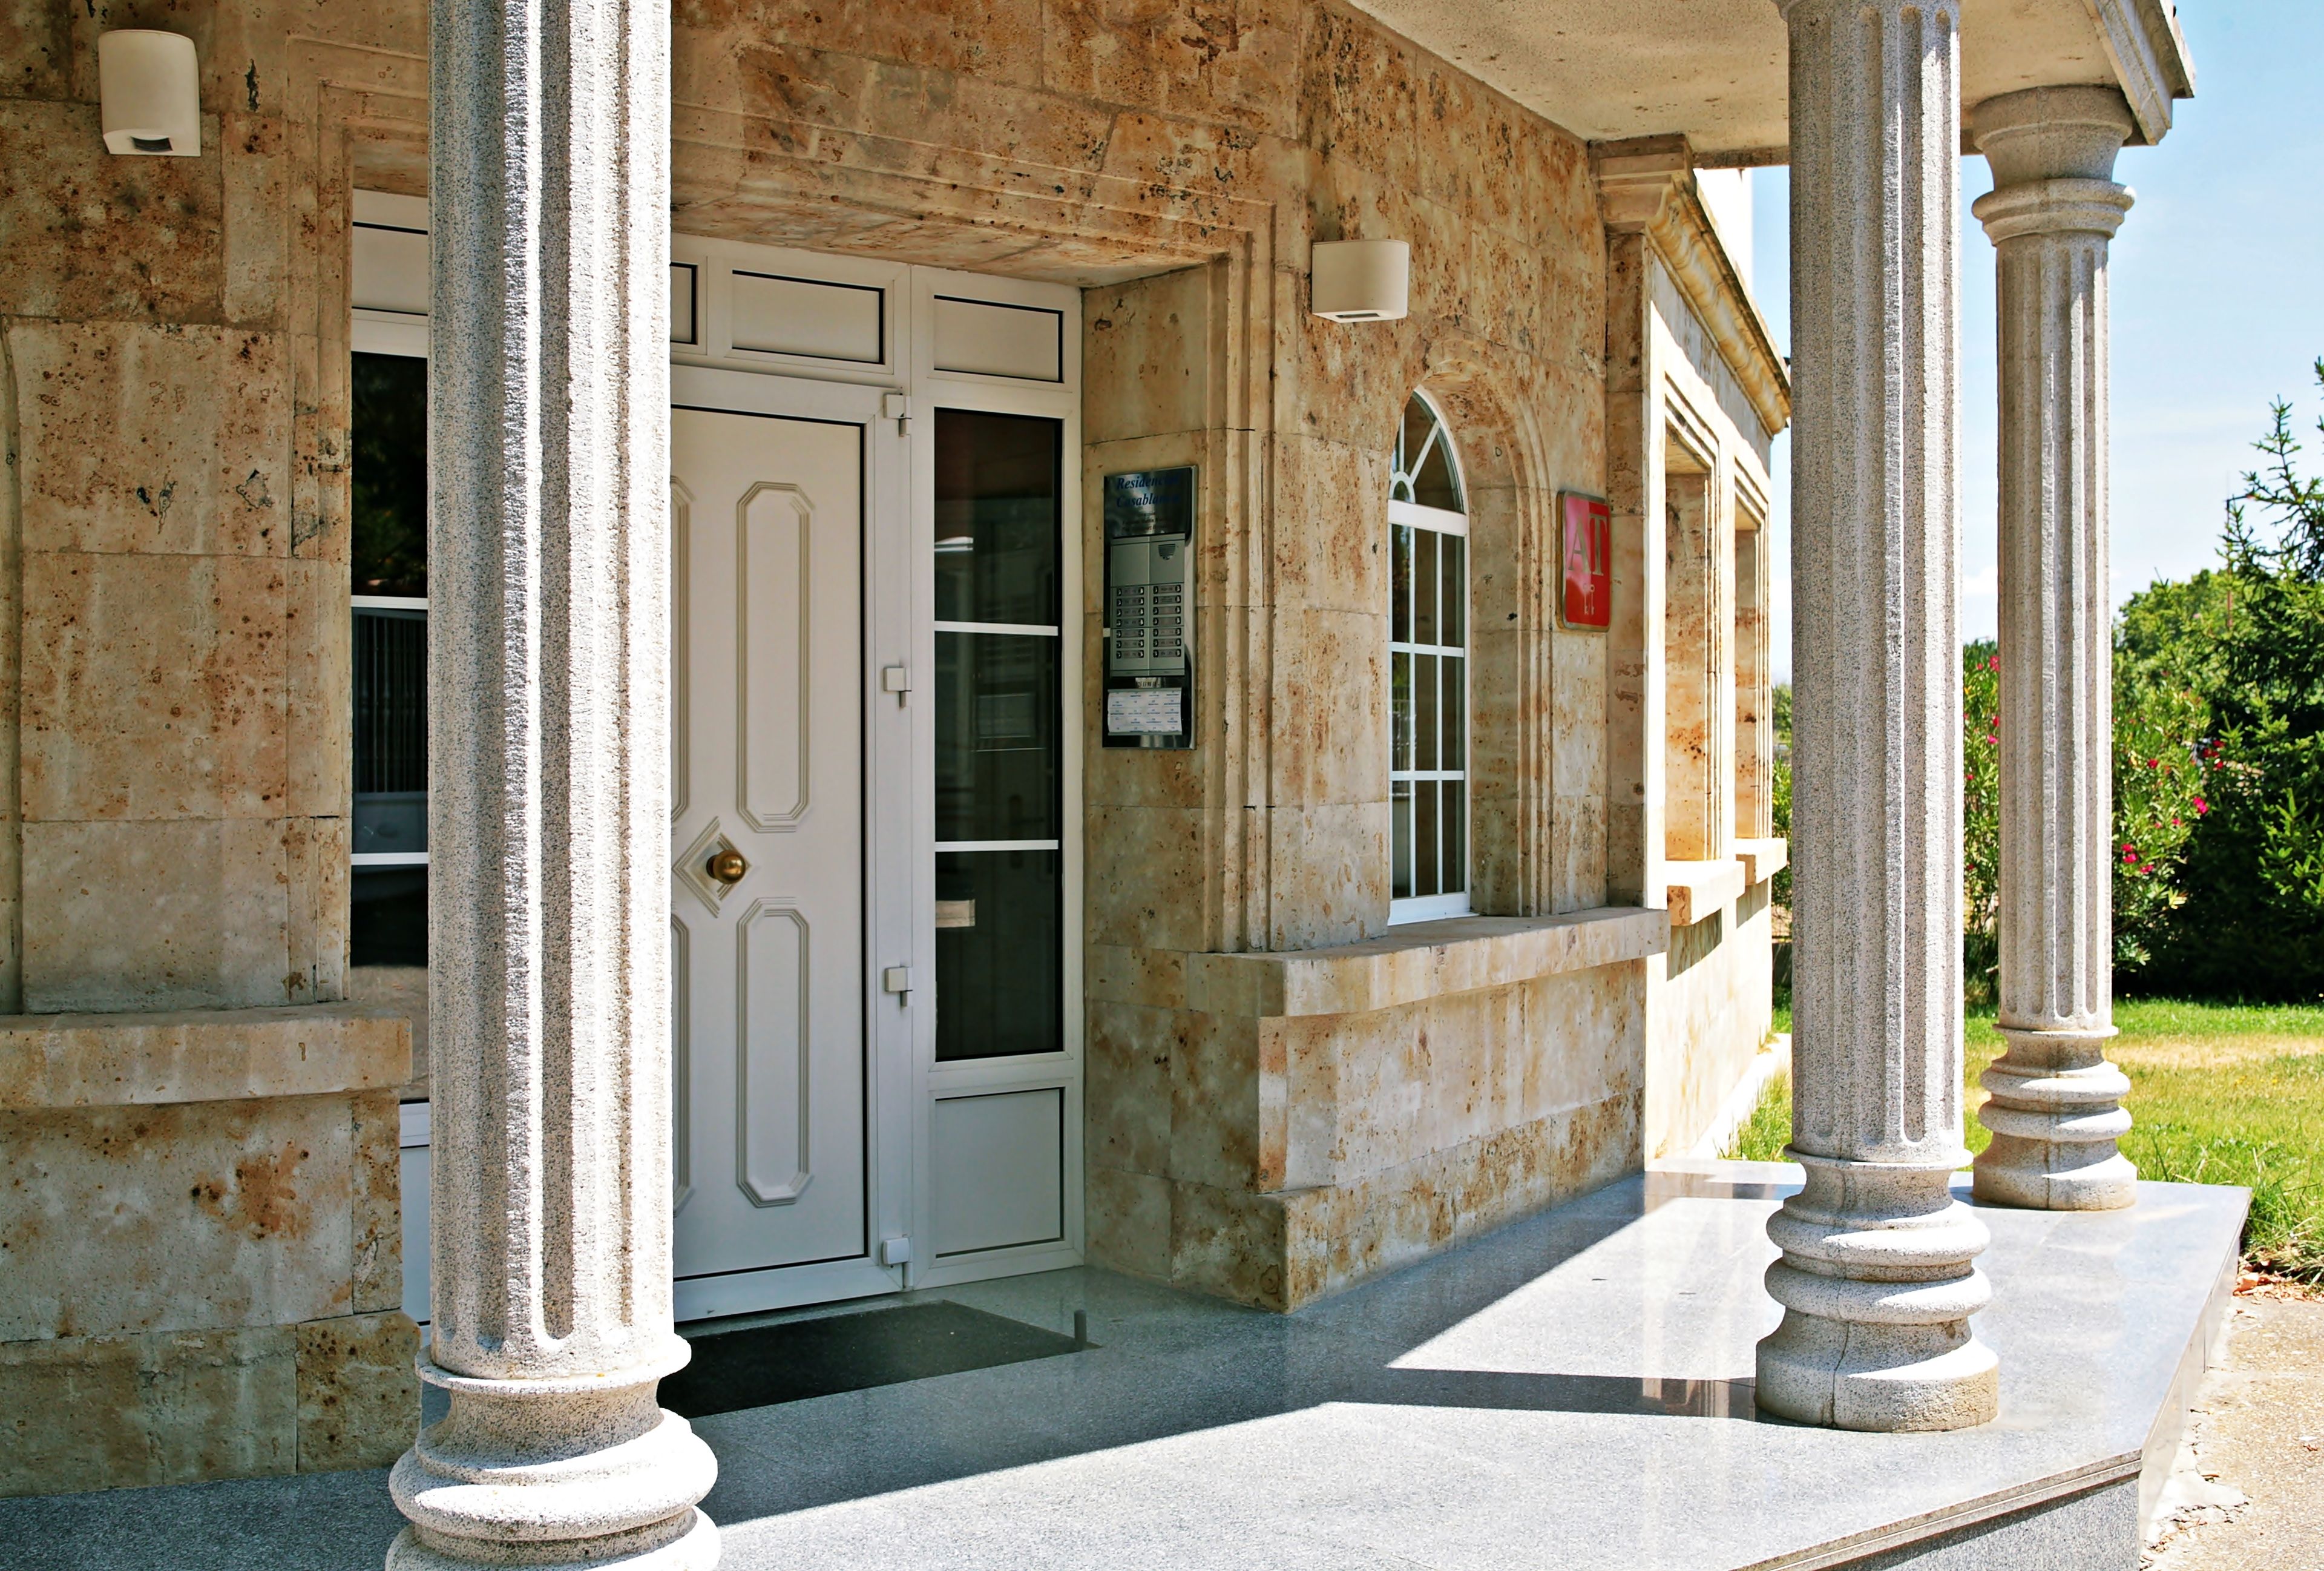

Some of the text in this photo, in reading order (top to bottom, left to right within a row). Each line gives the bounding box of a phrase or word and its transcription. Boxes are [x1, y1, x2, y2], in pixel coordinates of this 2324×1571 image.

[1117, 474, 1181, 489] Residenc
[1117, 493, 1181, 507] Casabla
[1568, 513, 1607, 576] AT
